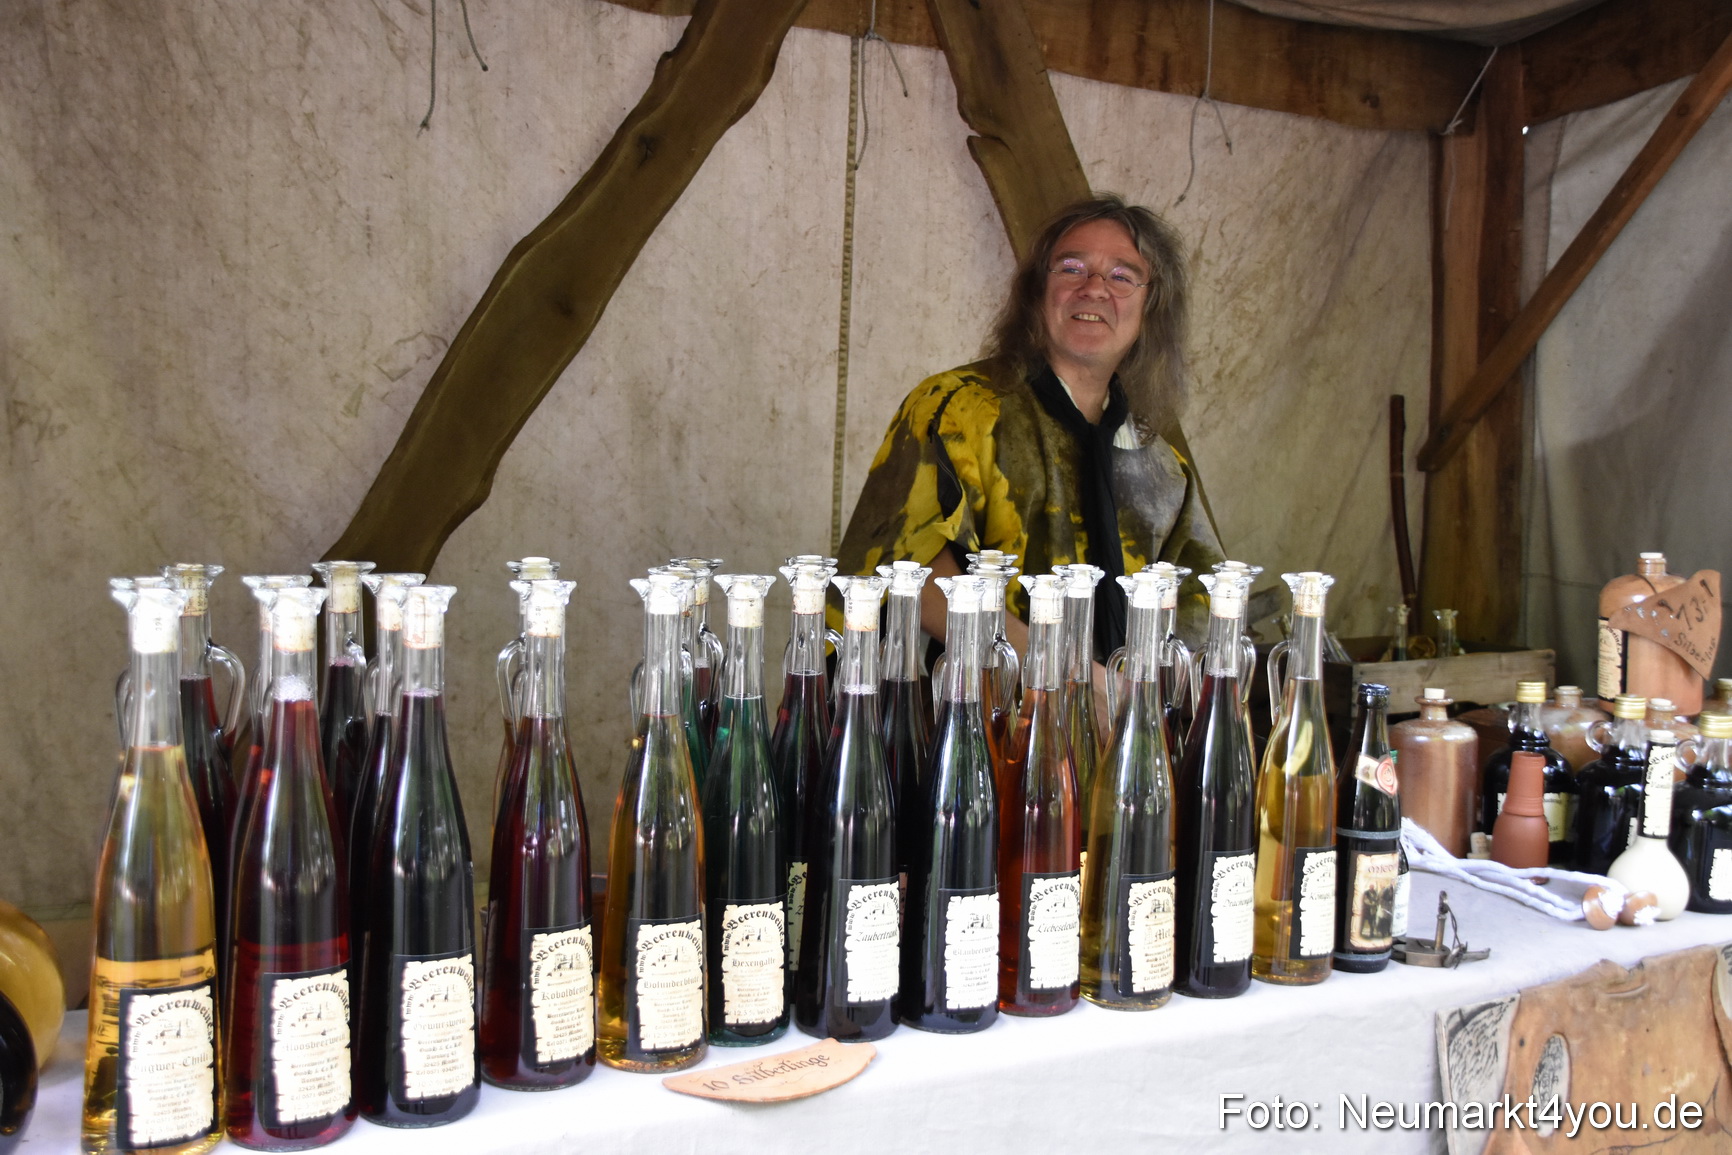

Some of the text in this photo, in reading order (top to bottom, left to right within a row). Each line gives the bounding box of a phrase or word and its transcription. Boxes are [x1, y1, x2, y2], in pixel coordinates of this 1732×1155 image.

[732, 957, 776, 968] Hexengalle
[702, 1053, 830, 1092] 10 Silberlinge
